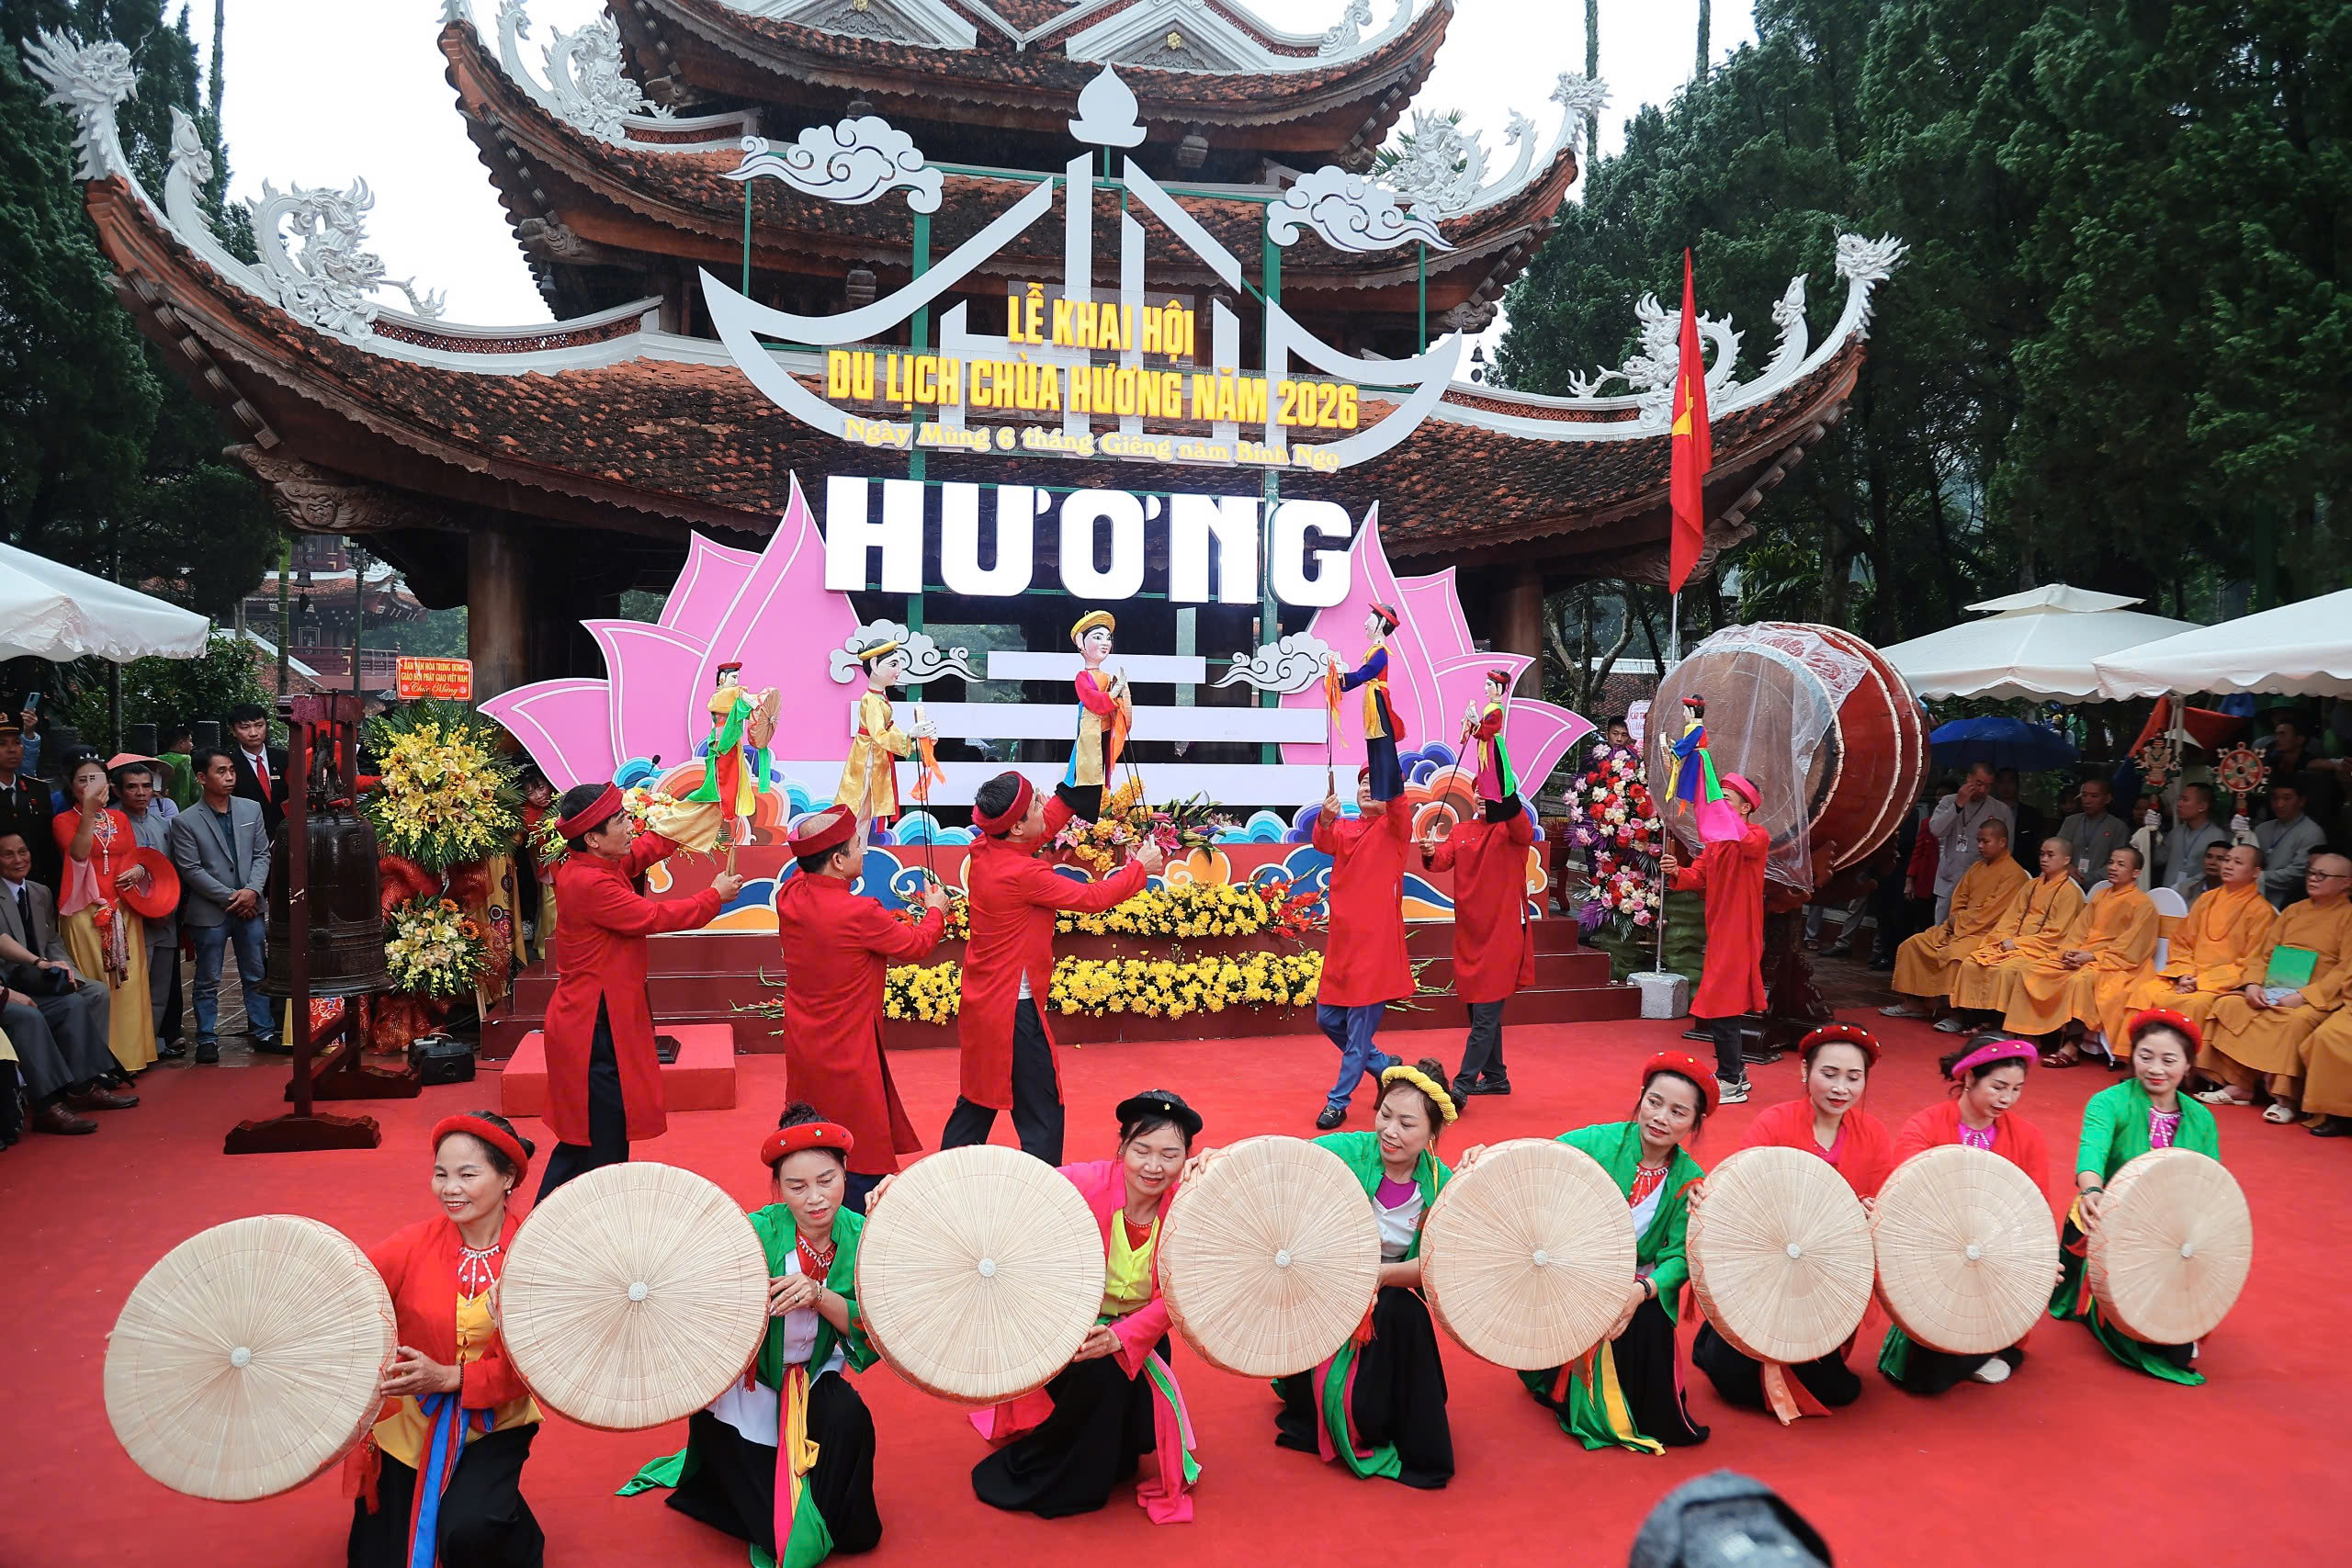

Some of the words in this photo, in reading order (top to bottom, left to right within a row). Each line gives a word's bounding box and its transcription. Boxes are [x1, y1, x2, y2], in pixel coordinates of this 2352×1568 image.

[1008, 282, 1045, 345] LỄ
[1052, 299, 1133, 352] KHAI
[1141, 299, 1194, 364] HỘI
[828, 349, 876, 400] DU
[886, 353, 960, 412] LỊCH
[969, 351, 1061, 411] CHÙA
[1069, 363, 1182, 419] HƯƠNG
[1192, 367, 1268, 424] NĂM
[1276, 379, 1359, 430] 2026
[844, 418, 910, 447] Ngày
[919, 423, 990, 450] Mùng
[999, 428, 1015, 448] 6
[1023, 427, 1094, 455] tháng
[1101, 434, 1171, 461] Giêng
[1178, 440, 1229, 459] năm
[1235, 441, 1289, 464] Bính
[1293, 446, 1340, 471] Ngọ
[825, 475, 1353, 607] HƯƠNG
[401, 671, 413, 681] GIÁO
[424, 671, 435, 682] PHẬT
[435, 671, 447, 682] GIÁO
[447, 672, 457, 683] VIỆT
[458, 674, 469, 683] NAM
[404, 660, 414, 671] BAN
[436, 662, 450, 671] TRUNG
